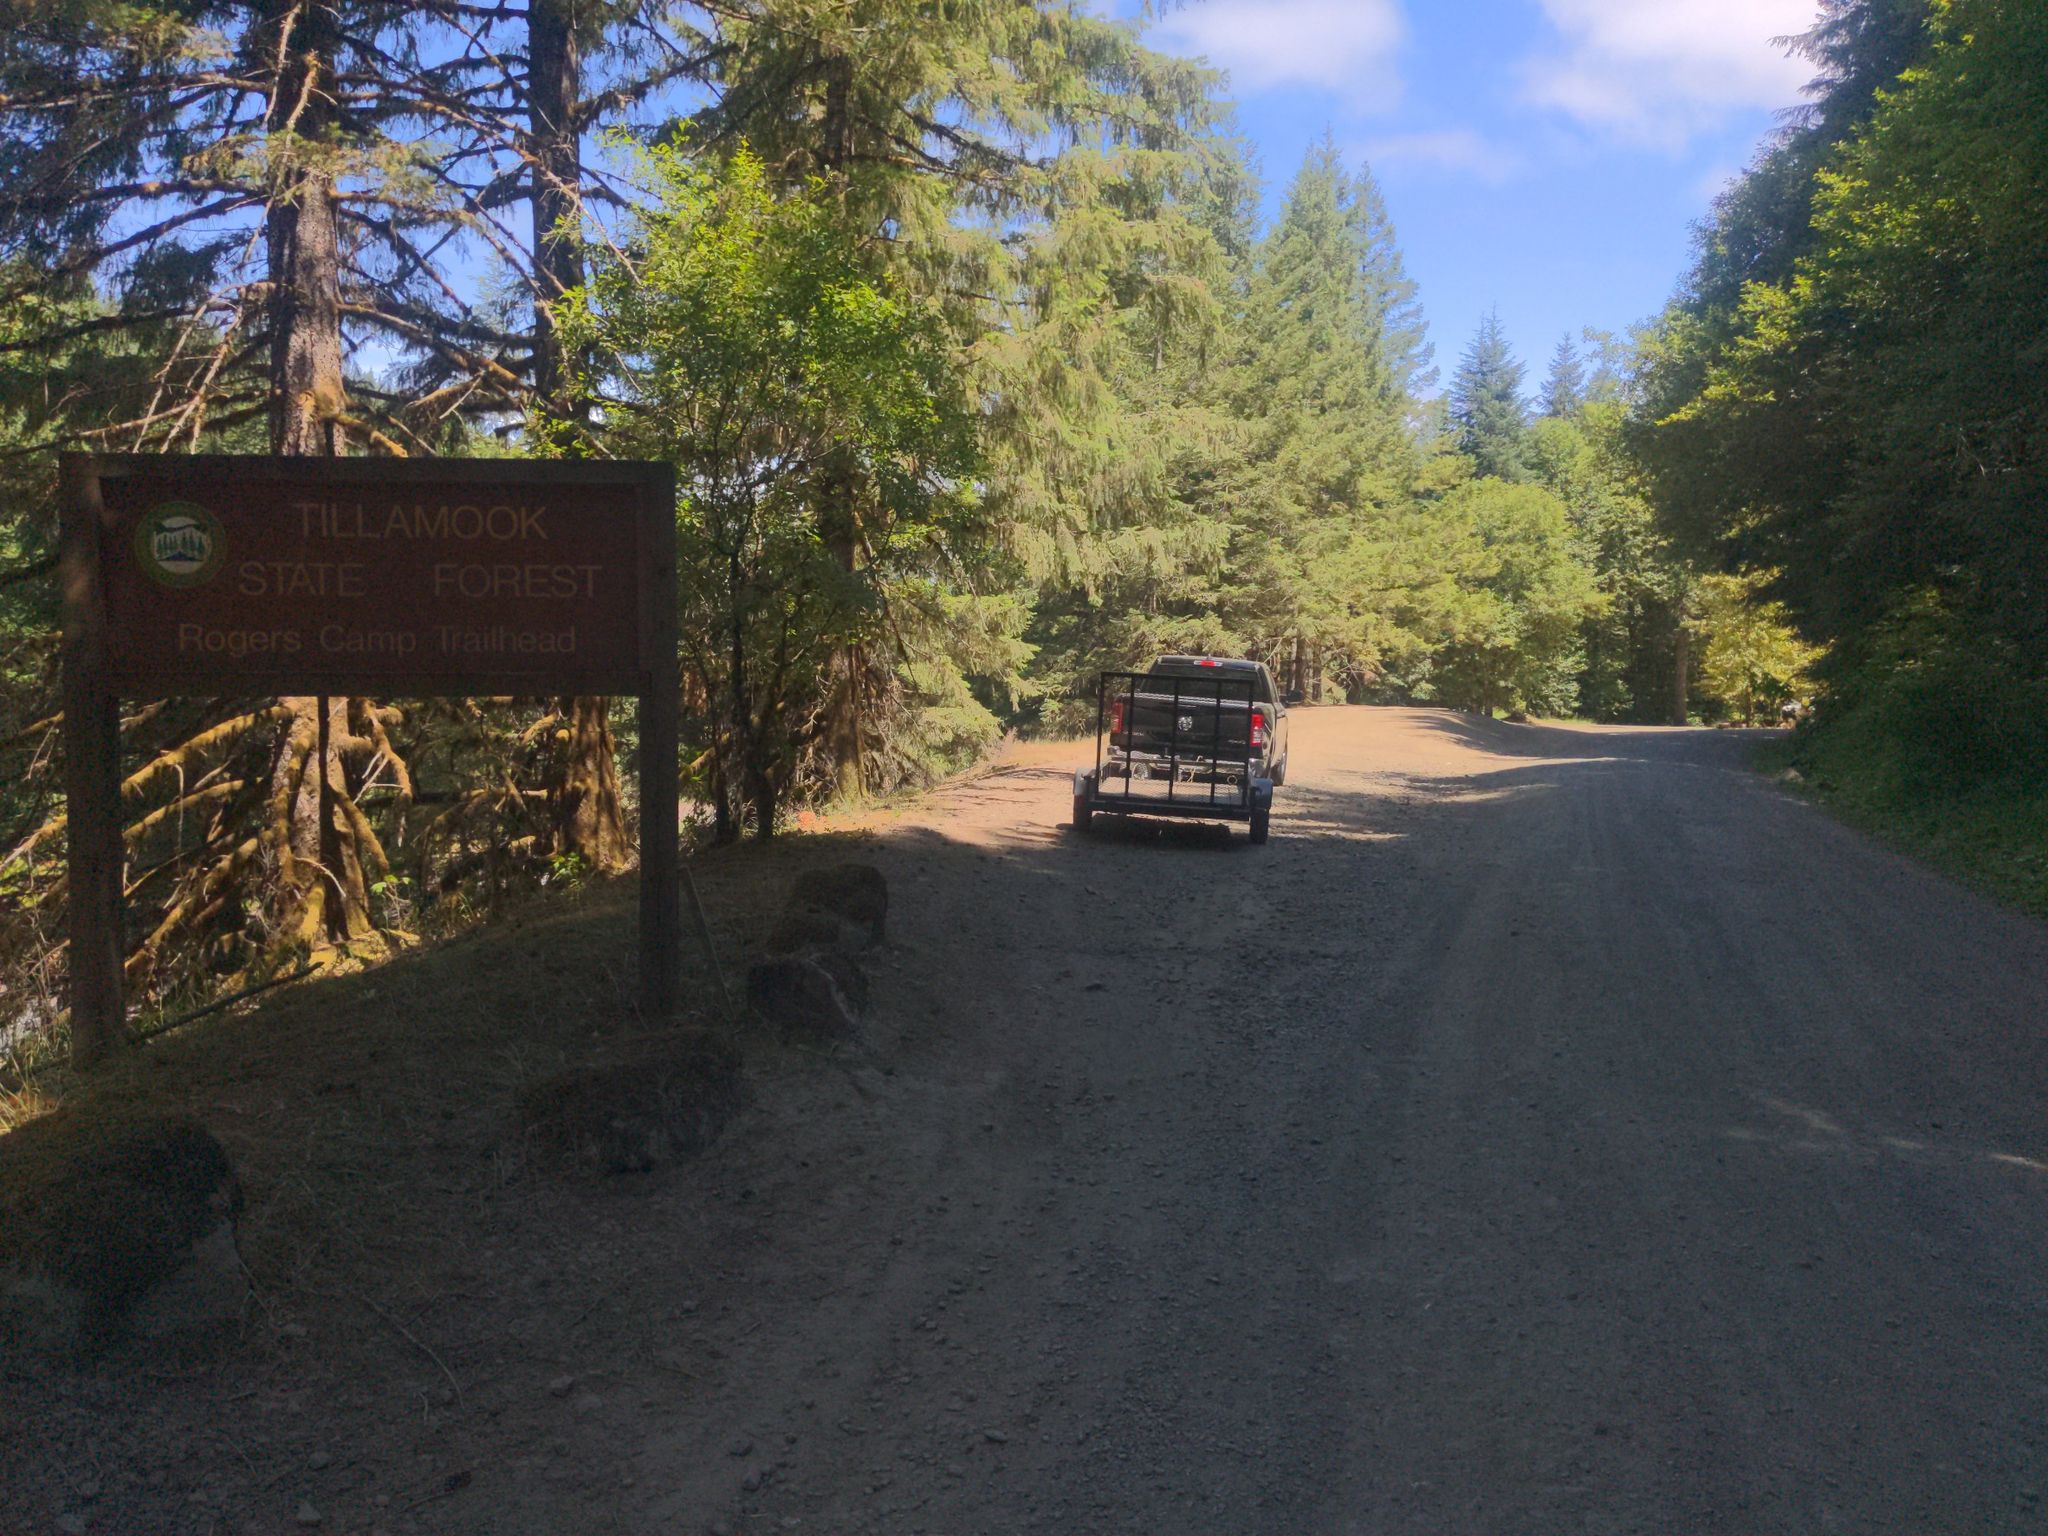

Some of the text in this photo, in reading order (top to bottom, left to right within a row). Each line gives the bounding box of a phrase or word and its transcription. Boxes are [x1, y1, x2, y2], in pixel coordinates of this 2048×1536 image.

[295, 503, 547, 541] TILLAMOOK
[239, 561, 603, 599] STATE FOREST
[178, 622, 577, 657] Rogers Camp Trailhead
